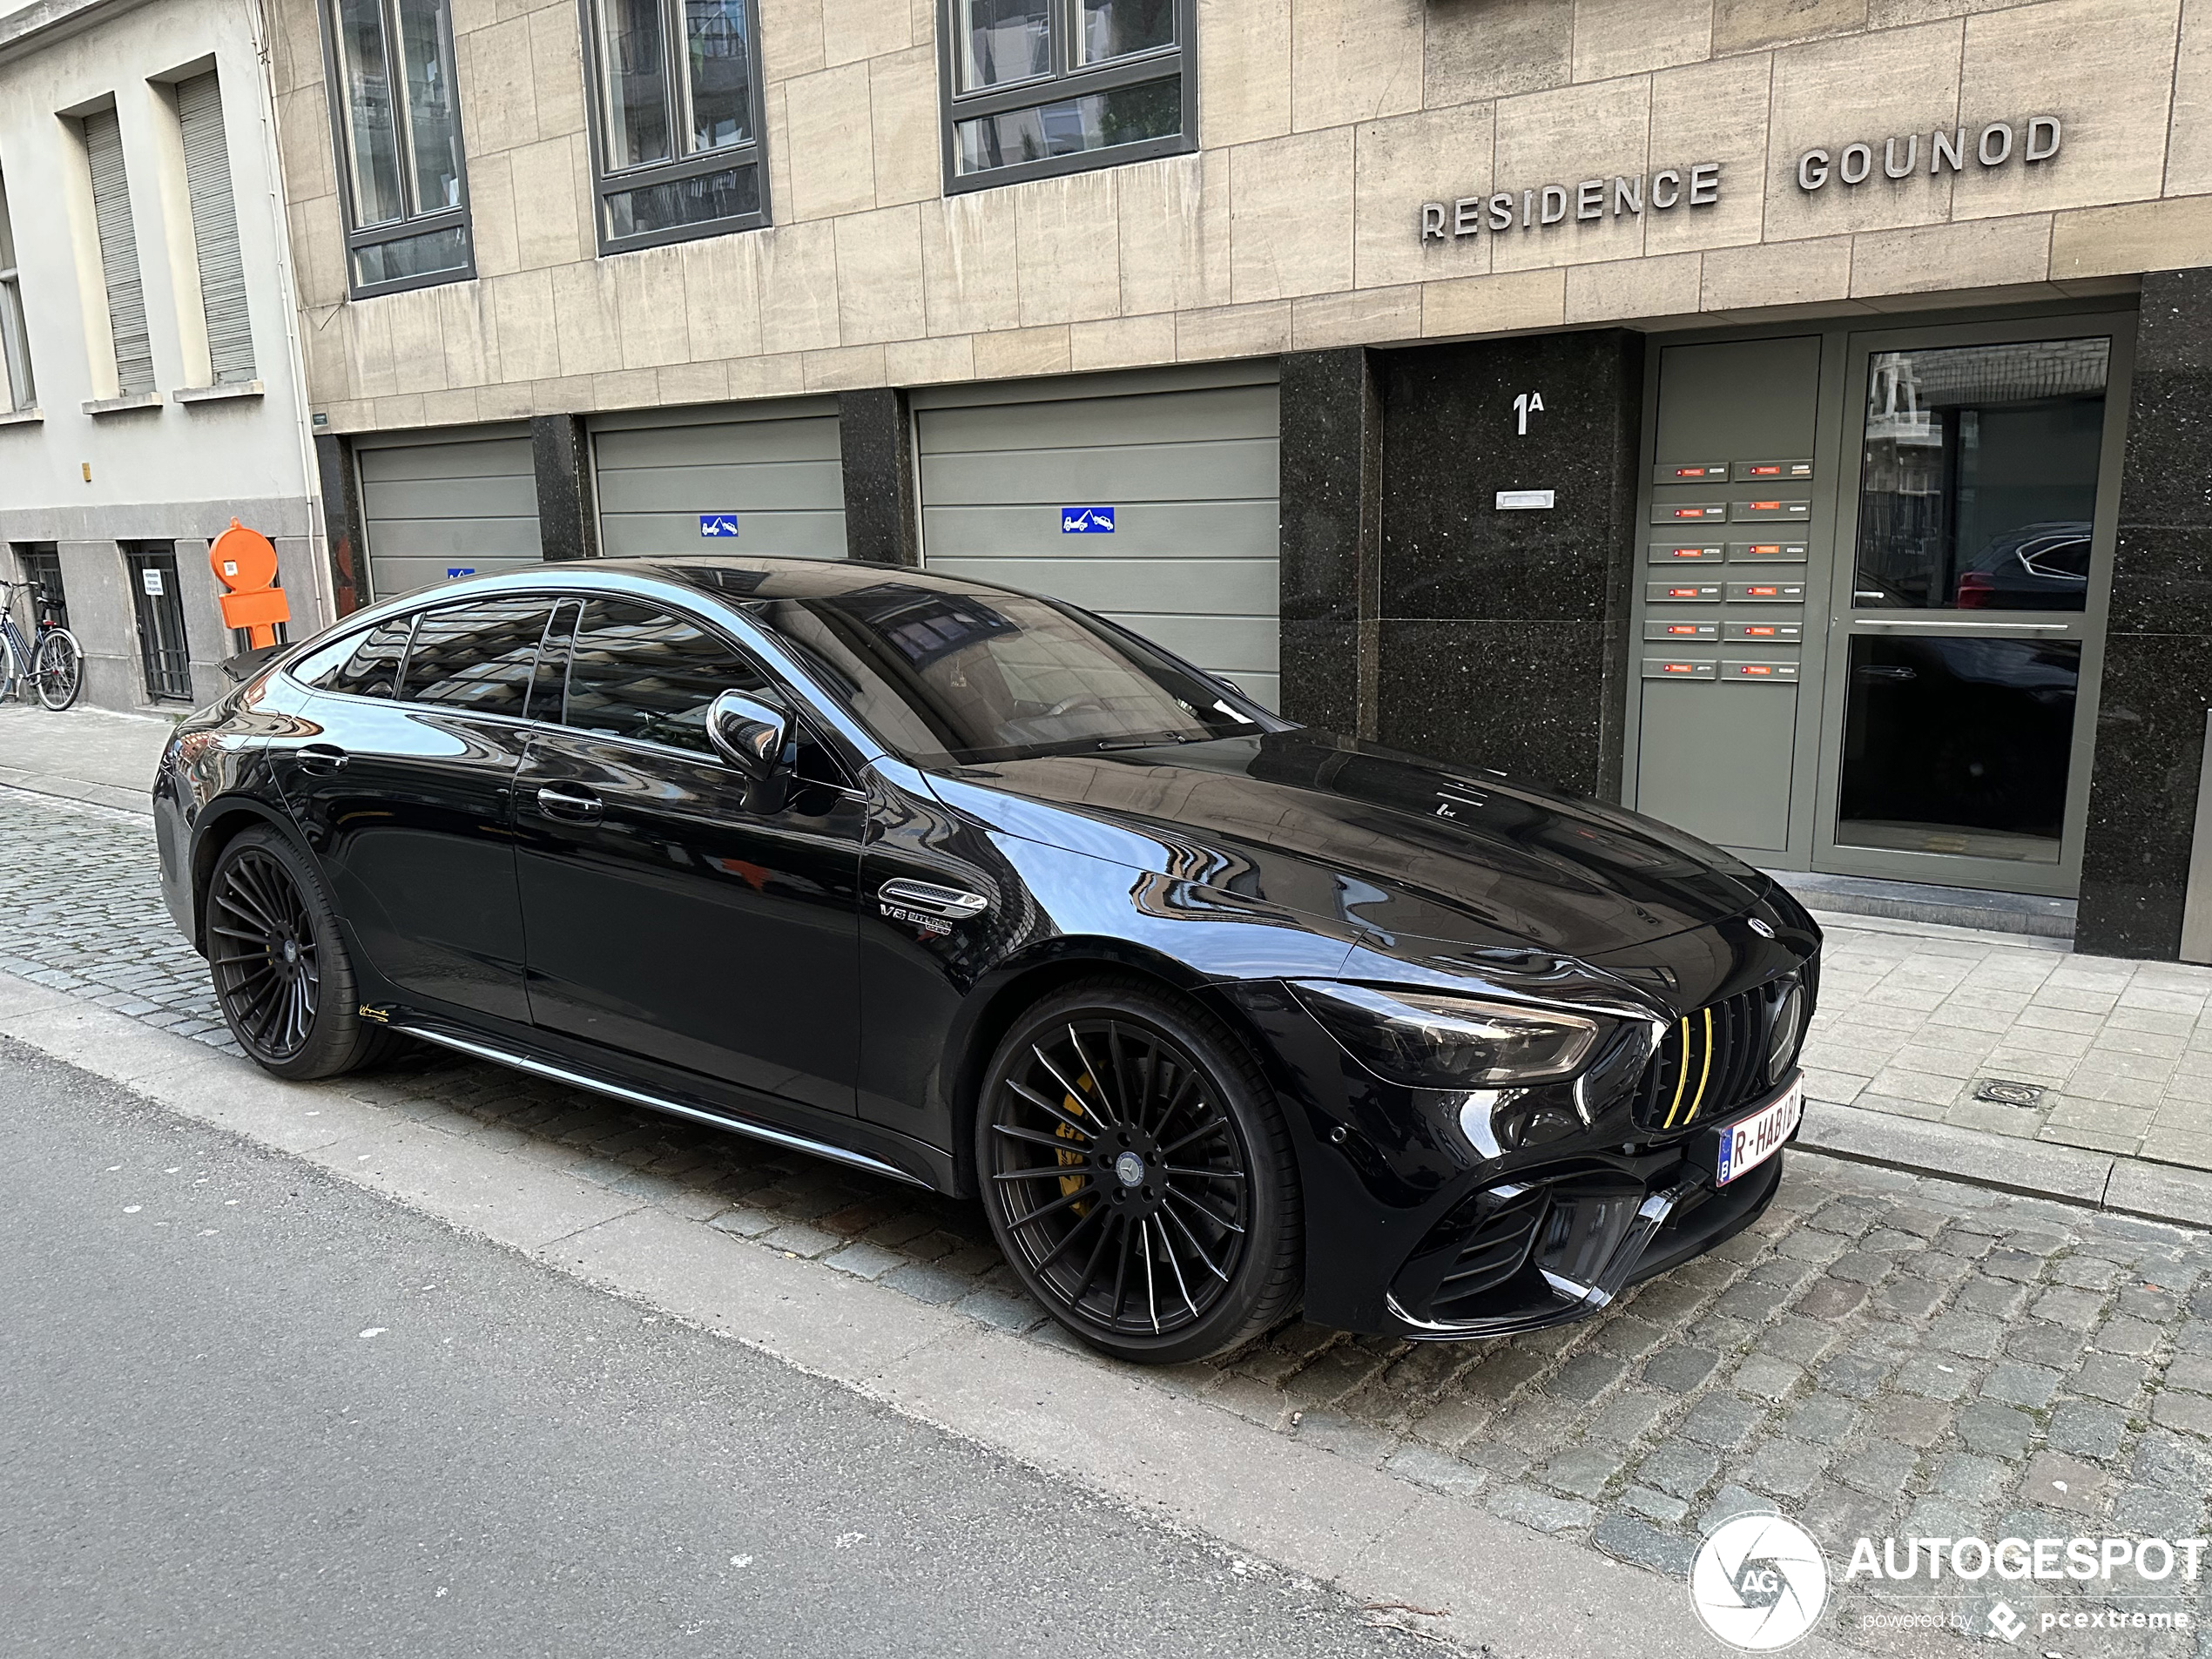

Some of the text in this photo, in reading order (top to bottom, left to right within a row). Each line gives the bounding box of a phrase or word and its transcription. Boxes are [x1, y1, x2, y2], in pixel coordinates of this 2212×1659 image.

[1422, 116, 2060, 239] RESIDENCE GOUNOD
[880, 904, 907, 920] V8
[1721, 1160, 1730, 1179] B
